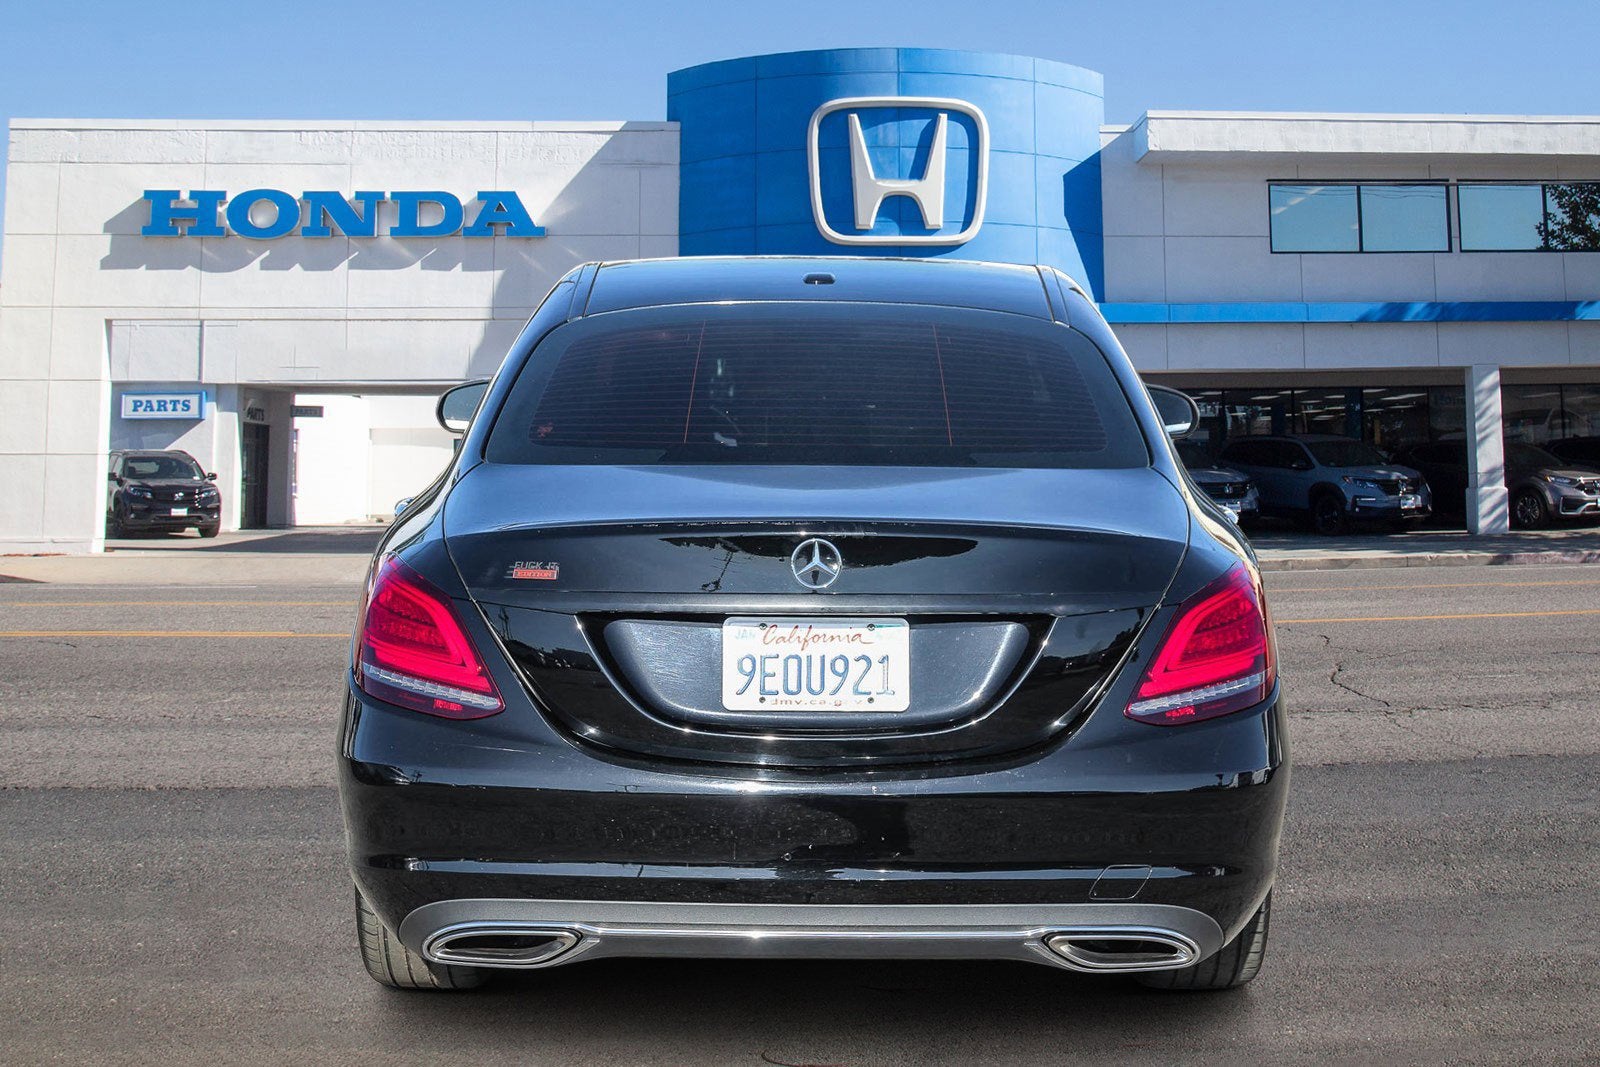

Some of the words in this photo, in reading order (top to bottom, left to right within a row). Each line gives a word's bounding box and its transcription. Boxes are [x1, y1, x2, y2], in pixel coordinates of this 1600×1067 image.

[142, 188, 547, 239] HONDA
[132, 399, 191, 412] PARTS
[762, 624, 875, 651] California
[770, 697, 864, 707] dmv.ca.gv
